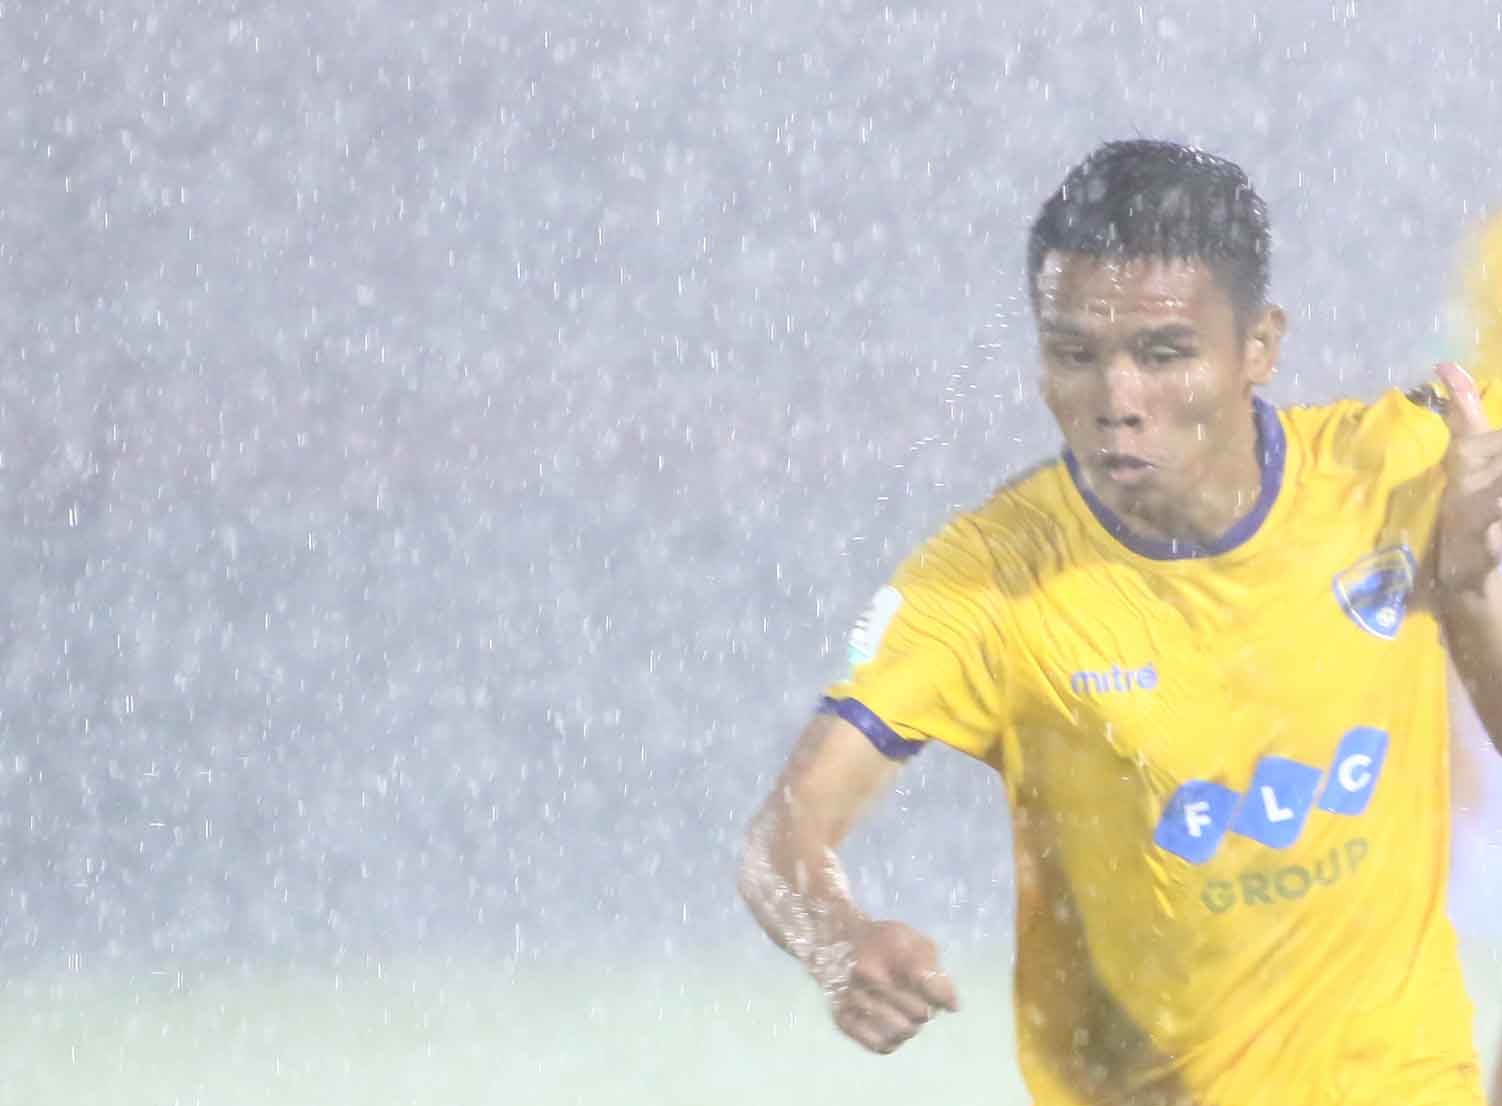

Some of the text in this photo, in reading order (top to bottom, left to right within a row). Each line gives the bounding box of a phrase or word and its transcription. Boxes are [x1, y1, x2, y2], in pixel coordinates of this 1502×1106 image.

[1071, 662, 1157, 695] mitre
[1183, 754, 1373, 837] FLC
[1202, 837, 1369, 914] GROUP
